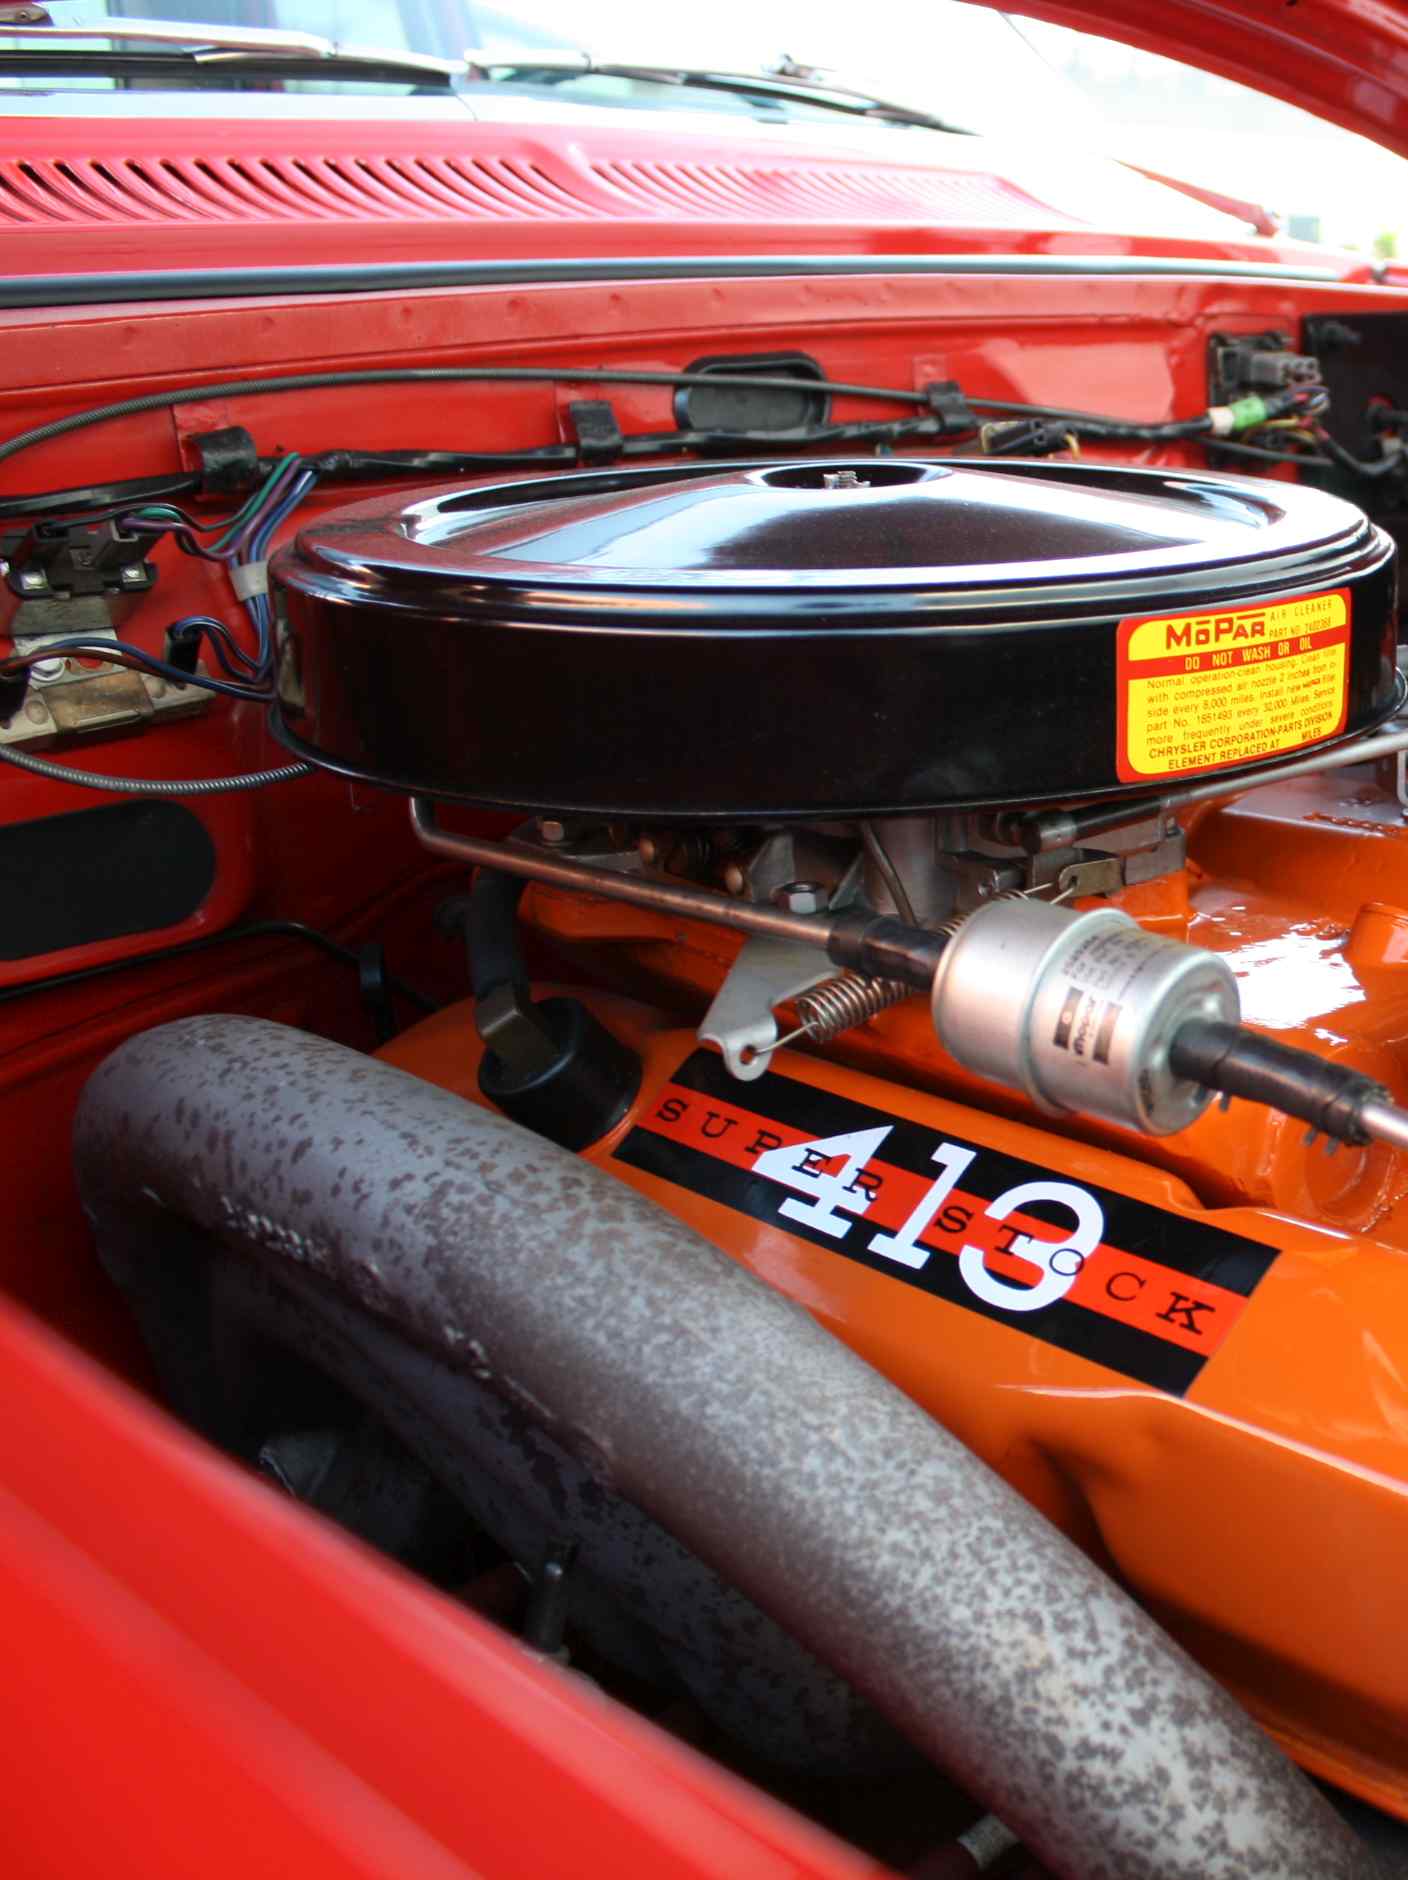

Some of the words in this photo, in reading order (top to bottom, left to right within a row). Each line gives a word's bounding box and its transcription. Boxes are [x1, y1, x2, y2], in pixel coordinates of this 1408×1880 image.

[1270, 608, 1287, 621] AIR
[1294, 599, 1332, 616] CLEANER
[1269, 627, 1288, 640] PART
[1184, 656, 1200, 671] DO
[1212, 651, 1233, 666] NOT
[1242, 645, 1271, 662] WASH
[1278, 641, 1290, 656] OR
[1299, 636, 1312, 651] OIL
[1147, 676, 1184, 689] Normal
[1147, 692, 1168, 704] with
[1174, 684, 1232, 700] compressed
[1147, 707, 1168, 717] side
[1173, 703, 1199, 715] every
[1147, 721, 1167, 735] part
[1147, 735, 1173, 745] more
[1183, 724, 1232, 742] frequently
[1149, 740, 1206, 759] CHRYSLER
[1304, 711, 1333, 729] DIVISION
[1168, 752, 1217, 770] ELEMENT
[1220, 742, 1268, 760] REPLACED
[1270, 738, 1281, 750] AT
[656, 1097, 885, 1202] SUPER
[935, 1204, 1215, 1335] STOCK
[751, 1124, 1103, 1312] 413
